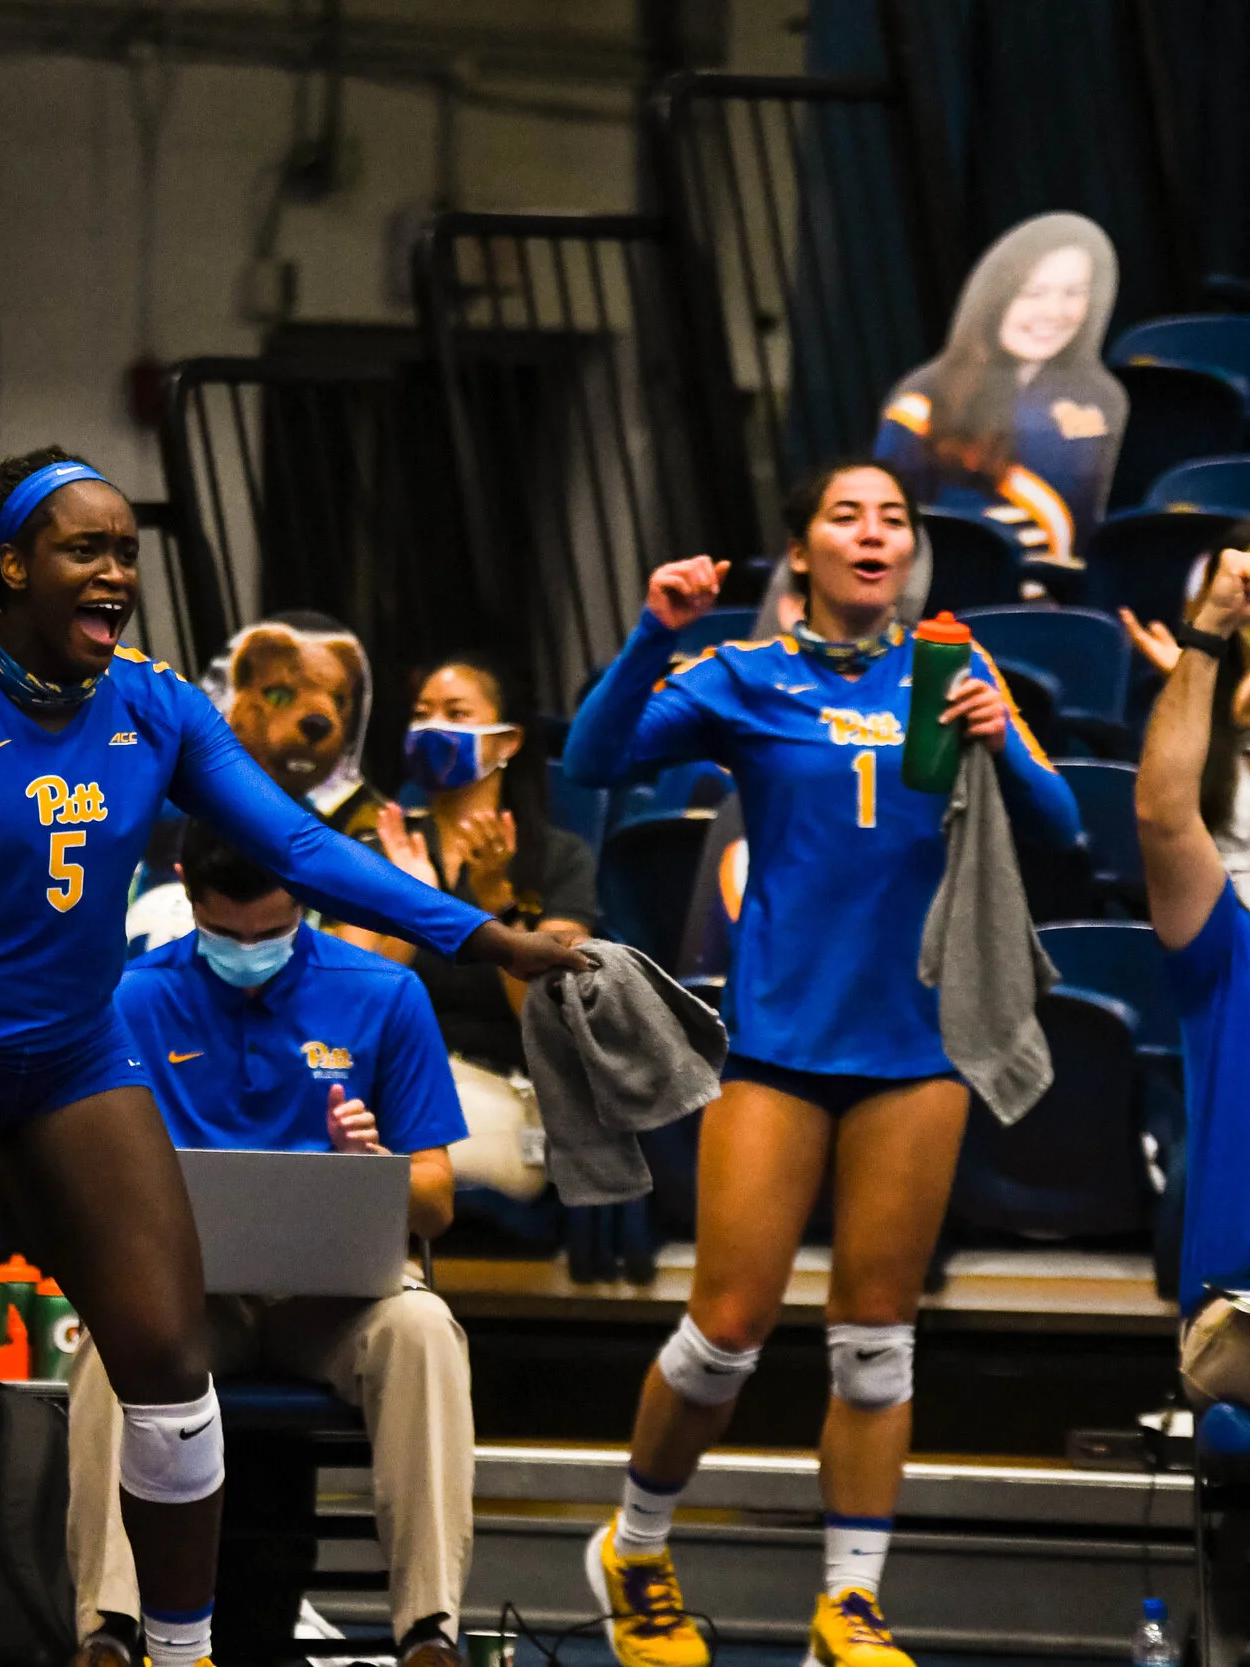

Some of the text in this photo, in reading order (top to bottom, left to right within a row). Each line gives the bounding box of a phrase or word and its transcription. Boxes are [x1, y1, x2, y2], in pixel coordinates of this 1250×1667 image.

[110, 731, 138, 744] ACC
[820, 707, 906, 746] Pitt
[26, 775, 108, 826] Pitt
[852, 750, 877, 829] 1
[46, 830, 87, 913] 5
[301, 1040, 354, 1069] Pitt
